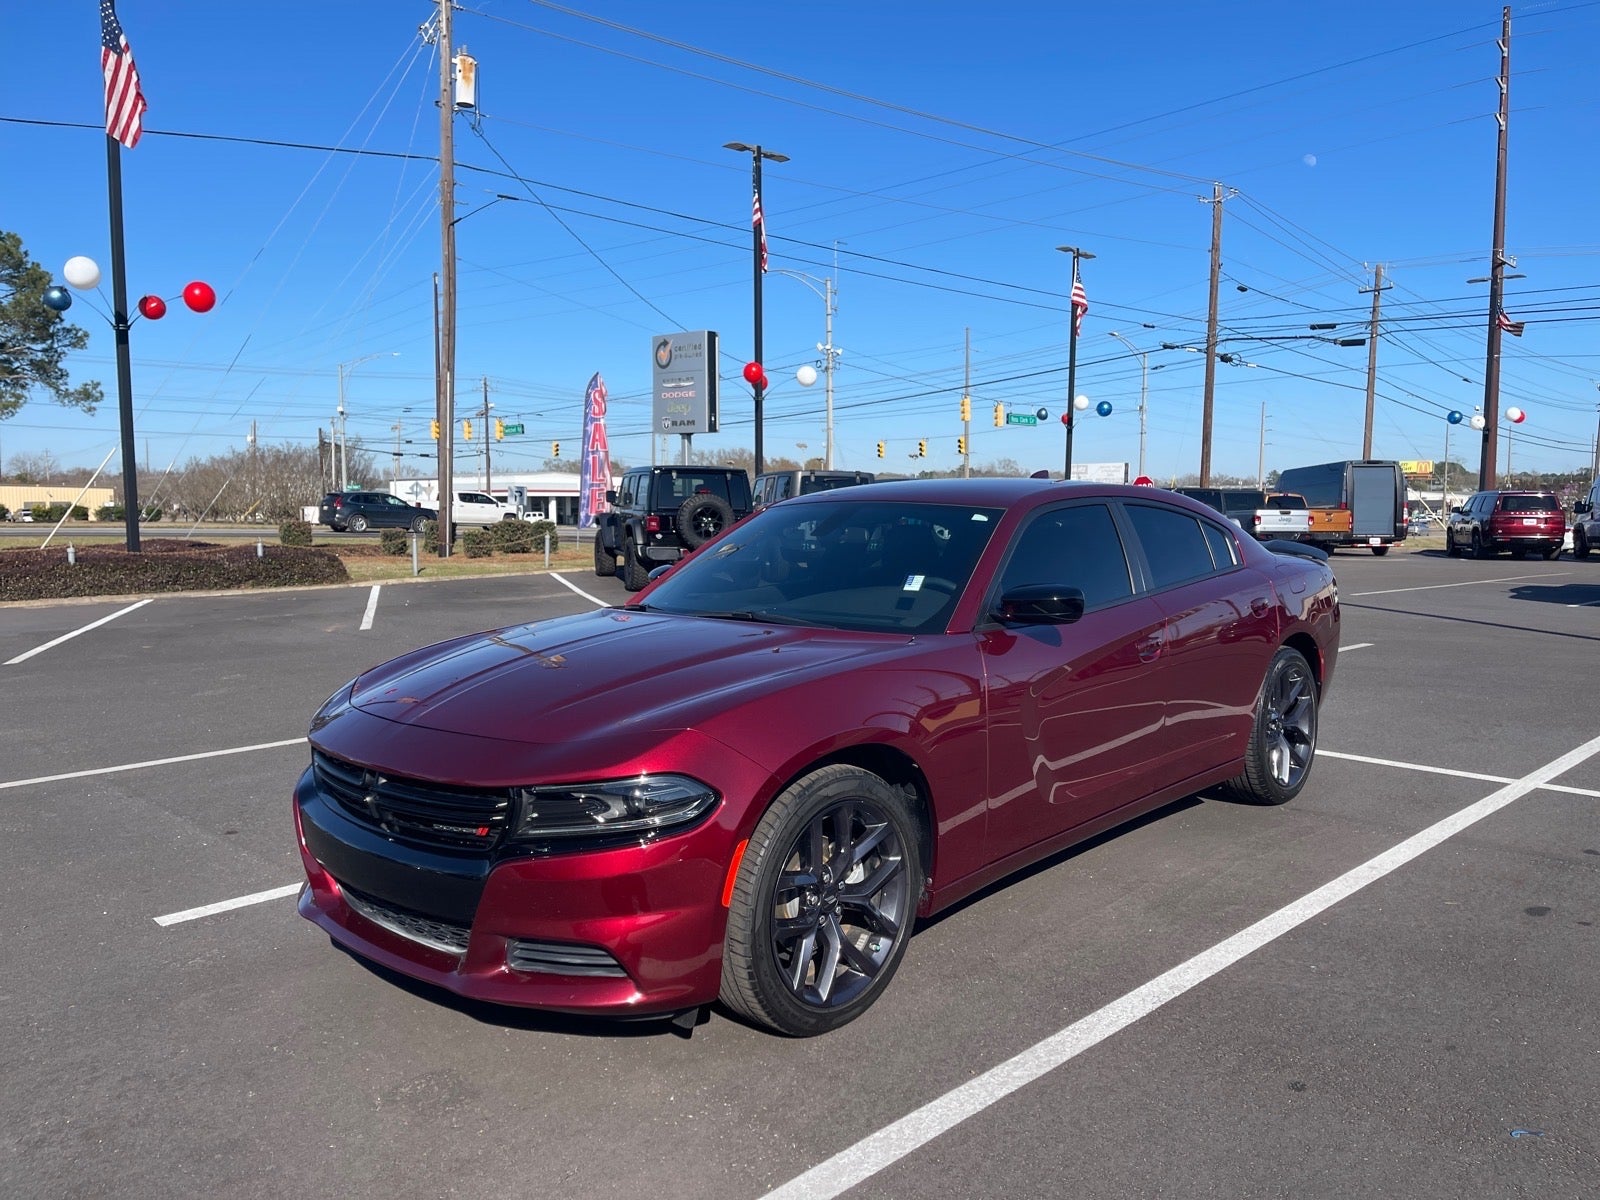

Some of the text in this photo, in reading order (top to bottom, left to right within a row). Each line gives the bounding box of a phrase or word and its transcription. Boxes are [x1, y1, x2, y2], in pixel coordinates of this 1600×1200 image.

[661, 390, 697, 399] DODGE
[672, 419, 696, 427] RAM
[588, 388, 609, 516] SALE
